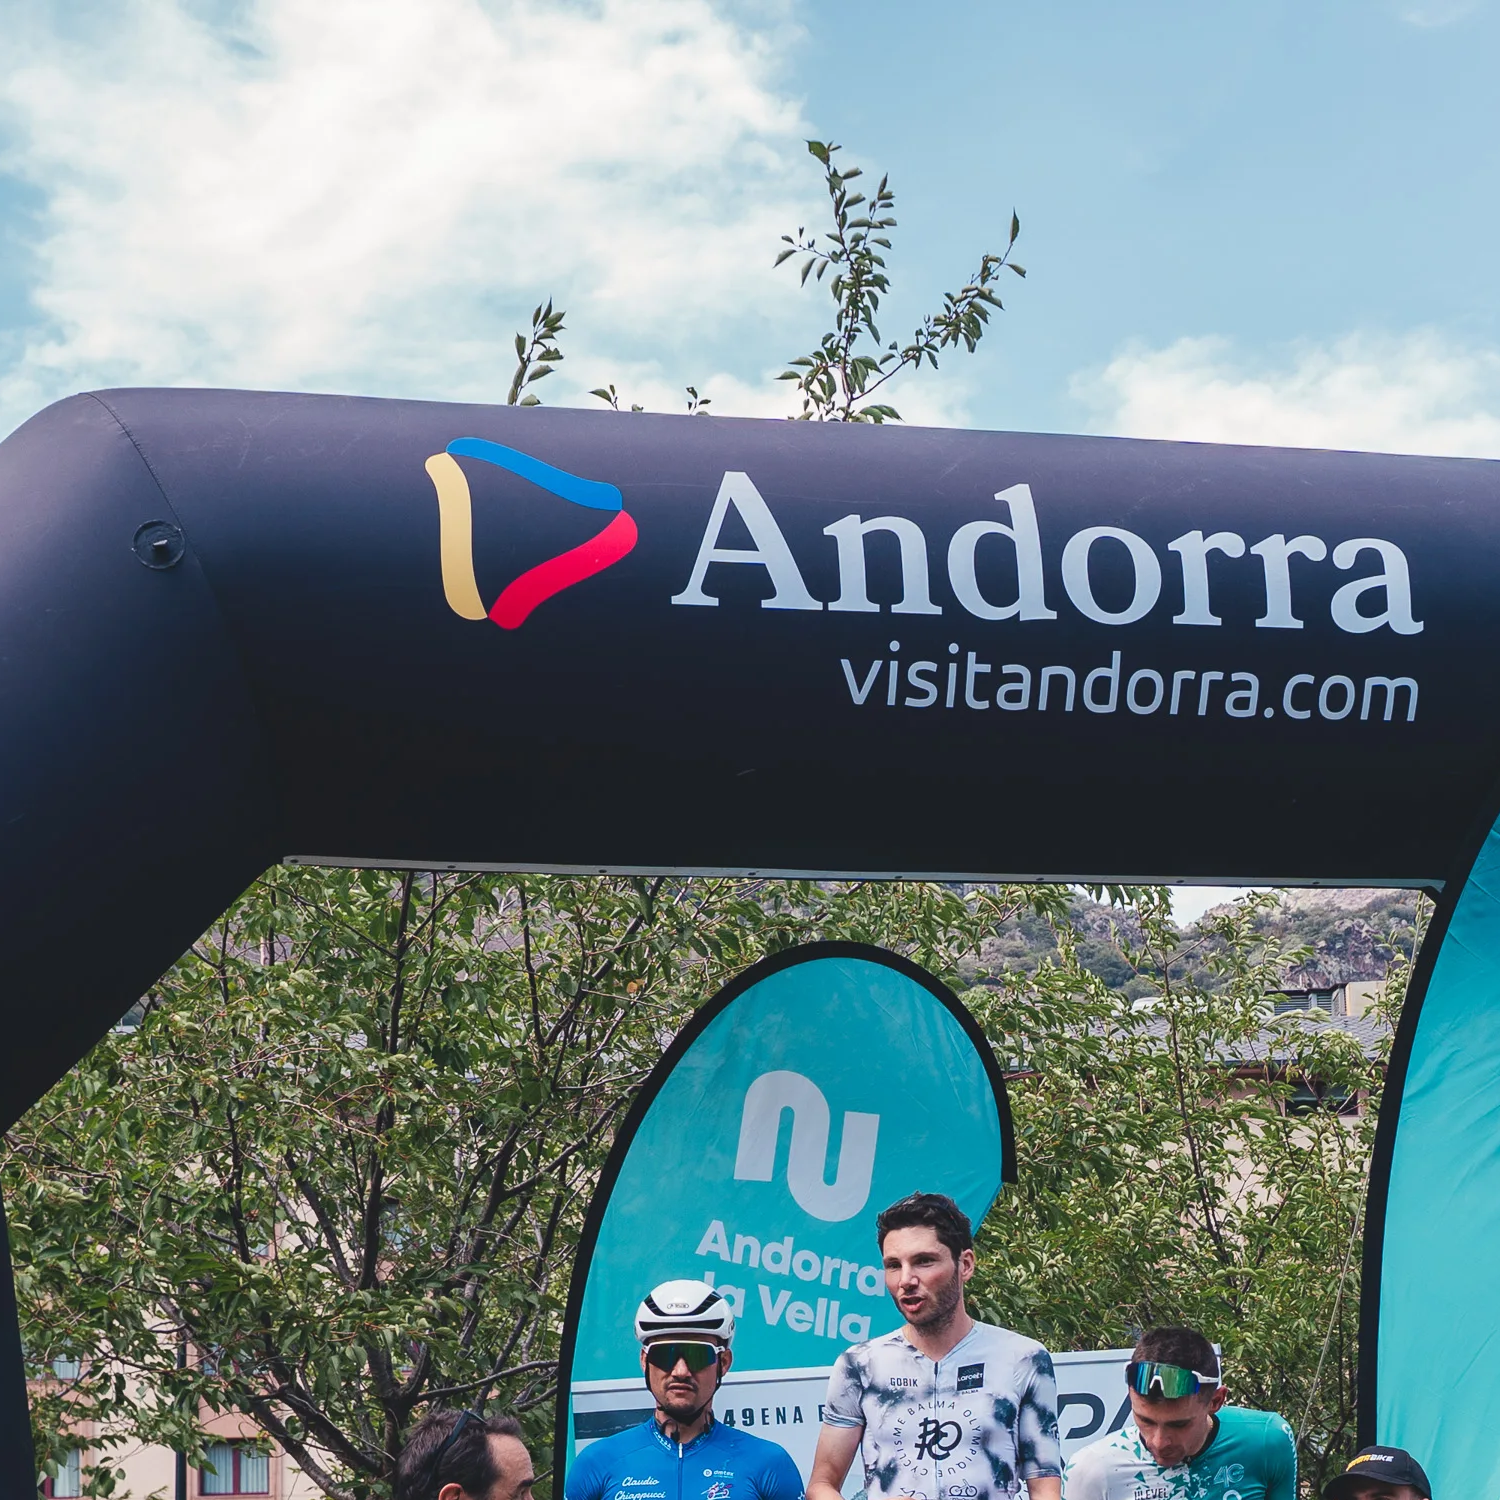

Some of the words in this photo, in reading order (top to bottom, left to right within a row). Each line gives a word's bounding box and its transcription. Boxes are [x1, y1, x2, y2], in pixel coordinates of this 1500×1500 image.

[671, 470, 1424, 635] Andorra
[841, 641, 1420, 722] visitandorra.com
[695, 1219, 886, 1297] Andorra
[758, 1284, 872, 1343] Vella
[890, 1378, 918, 1387] GOBIK
[724, 1405, 803, 1427] 49ENA
[907, 1400, 956, 1416] BALMA
[622, 1477, 660, 1487] Claudio
[615, 1490, 666, 1500] Chiappucci
